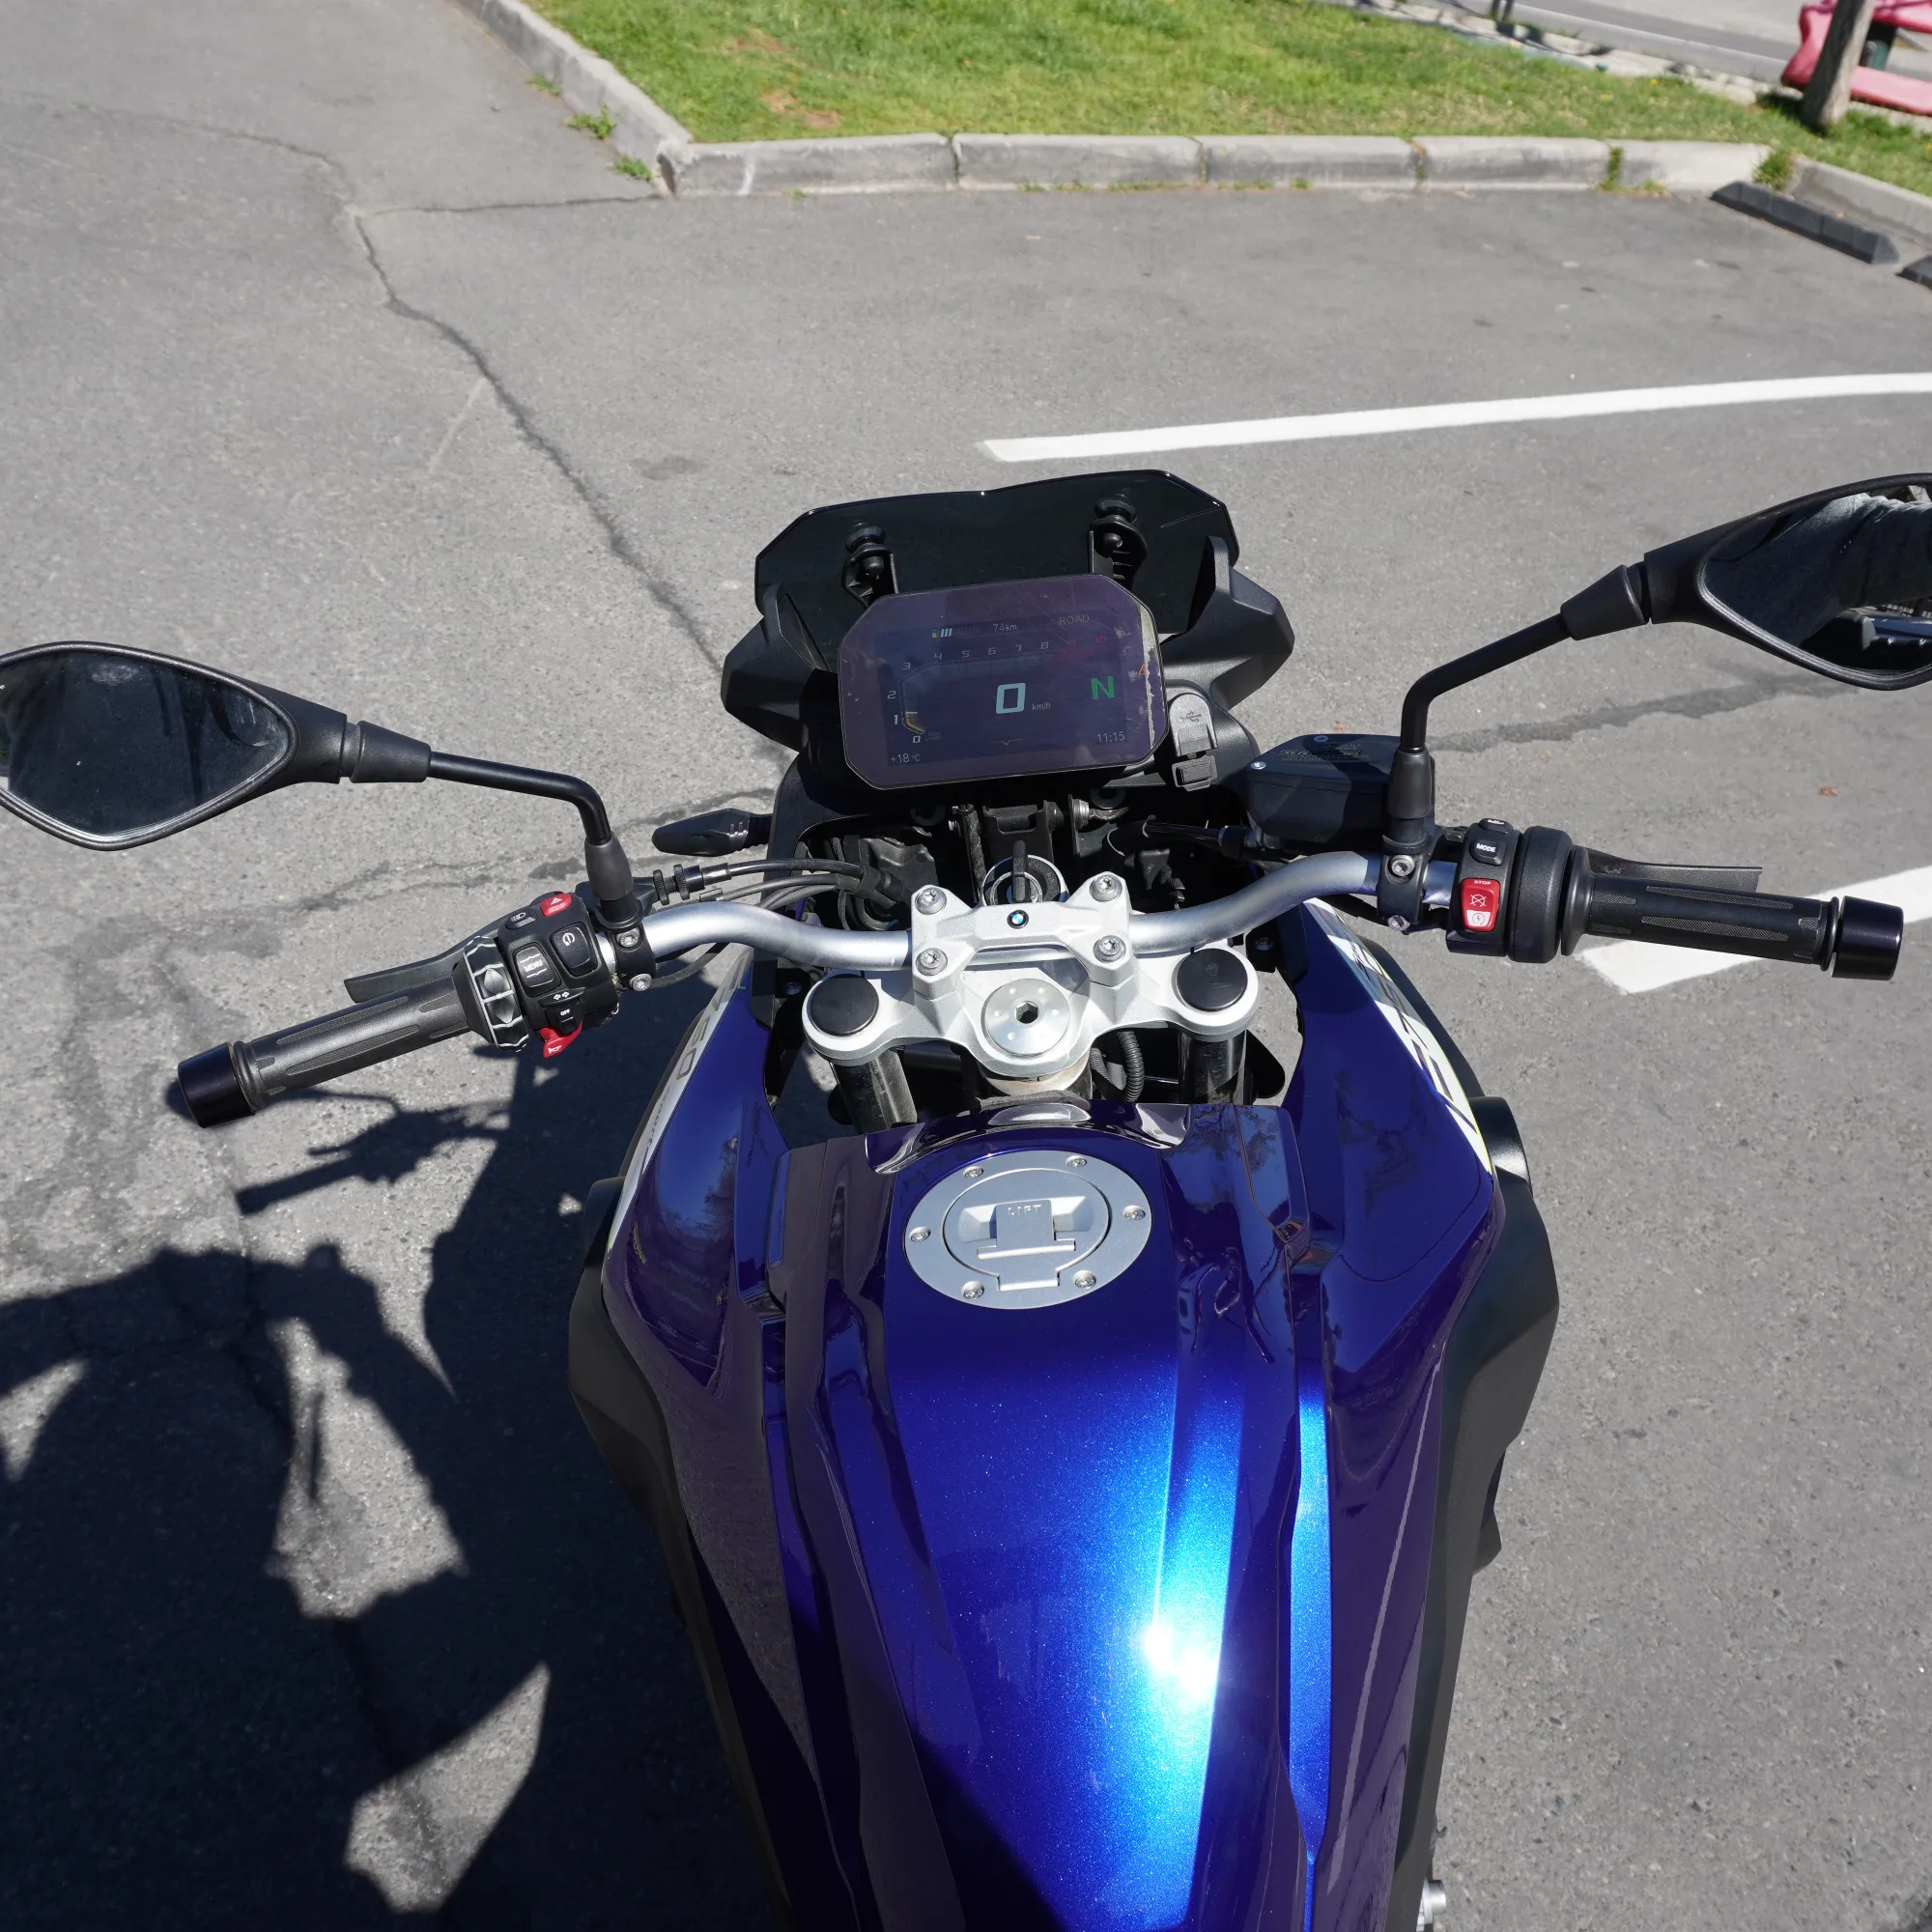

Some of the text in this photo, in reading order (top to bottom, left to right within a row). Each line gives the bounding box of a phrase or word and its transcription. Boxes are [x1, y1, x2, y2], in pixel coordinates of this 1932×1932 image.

[1059, 614, 1090, 626] ROAD
[1014, 643, 1022, 652] 7
[1040, 640, 1049, 650] 8
[961, 649, 970, 658] 5
[987, 646, 997, 656] 6
[933, 652, 943, 661] 4
[902, 662, 911, 670] 3
[1091, 675, 1115, 700] N
[887, 690, 896, 699] 2
[995, 682, 1051, 715] 0 km/h
[894, 714, 899, 725] 1
[912, 735, 922, 744] 0
[1096, 730, 1125, 743] 11:15
[1476, 842, 1496, 853] MODE
[524, 959, 543, 974] MENU
[560, 1008, 571, 1016] OFF
[1008, 1204, 1042, 1216] LIFT
